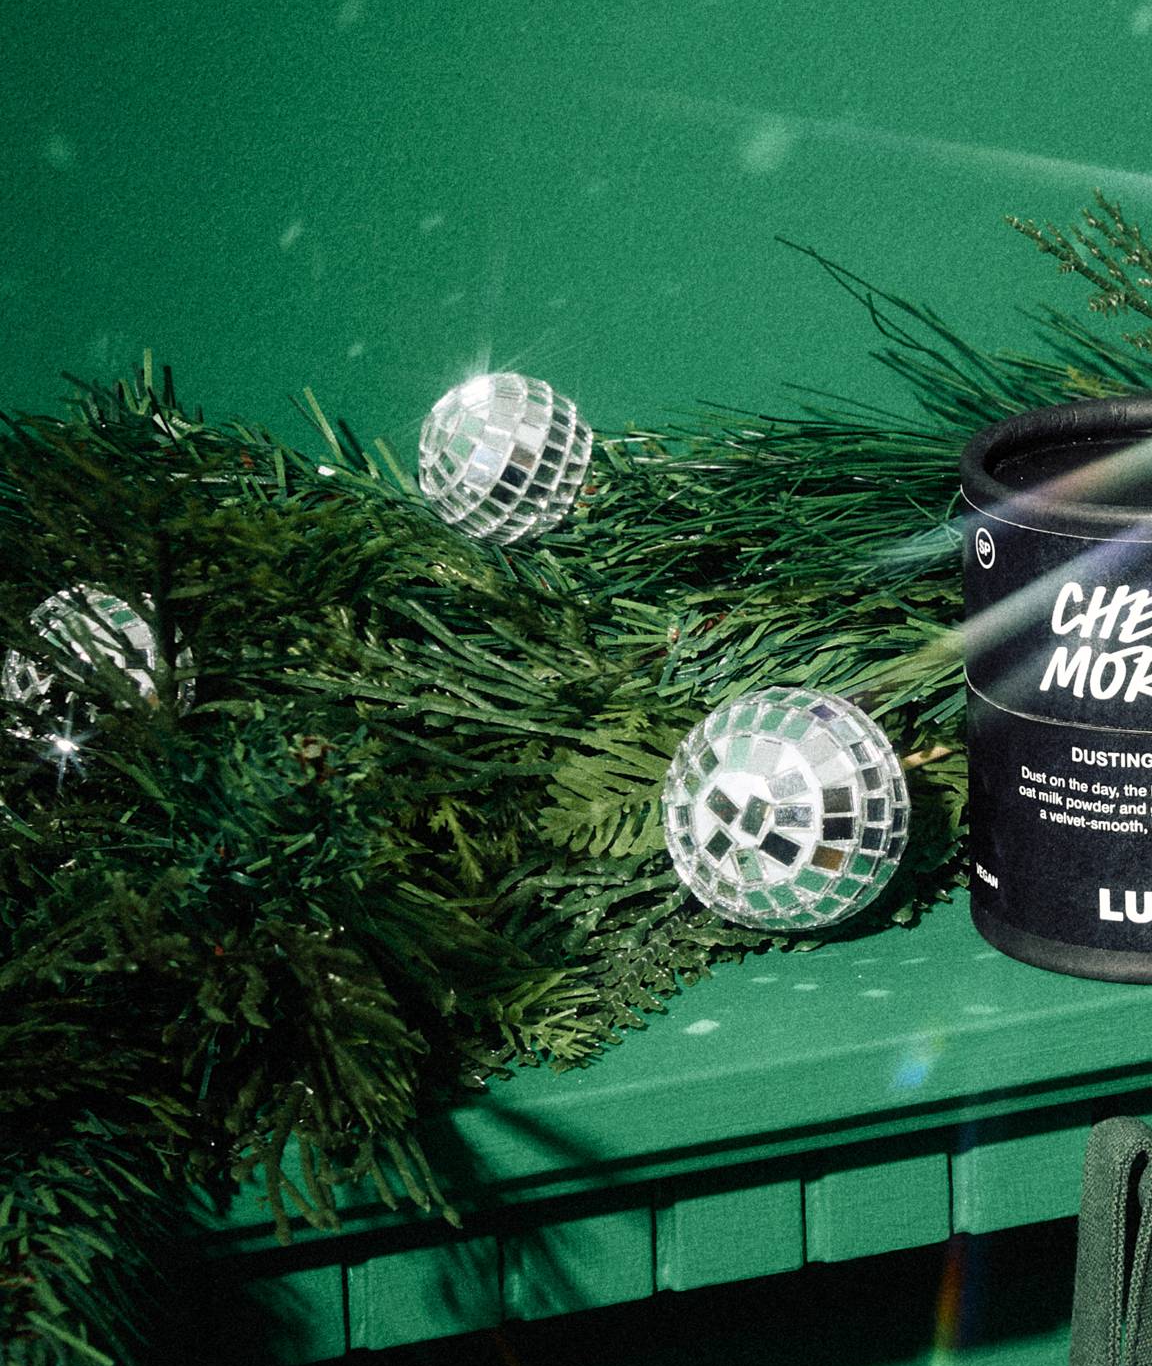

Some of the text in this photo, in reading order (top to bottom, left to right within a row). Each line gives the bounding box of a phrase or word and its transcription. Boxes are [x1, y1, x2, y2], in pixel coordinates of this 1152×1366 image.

[979, 538, 991, 556] SP
[1021, 765, 1047, 784] Dust
[1049, 775, 1066, 788] on
[1069, 777, 1088, 792] the
[1091, 782, 1120, 798] day,
[1124, 784, 1147, 797] the
[1018, 785, 1037, 799] oat
[1038, 791, 1063, 806] milk
[1066, 797, 1116, 814] powder
[1119, 802, 1146, 815] and
[1039, 808, 1047, 820] a
[1049, 811, 1148, 835] velvet-smooth,
